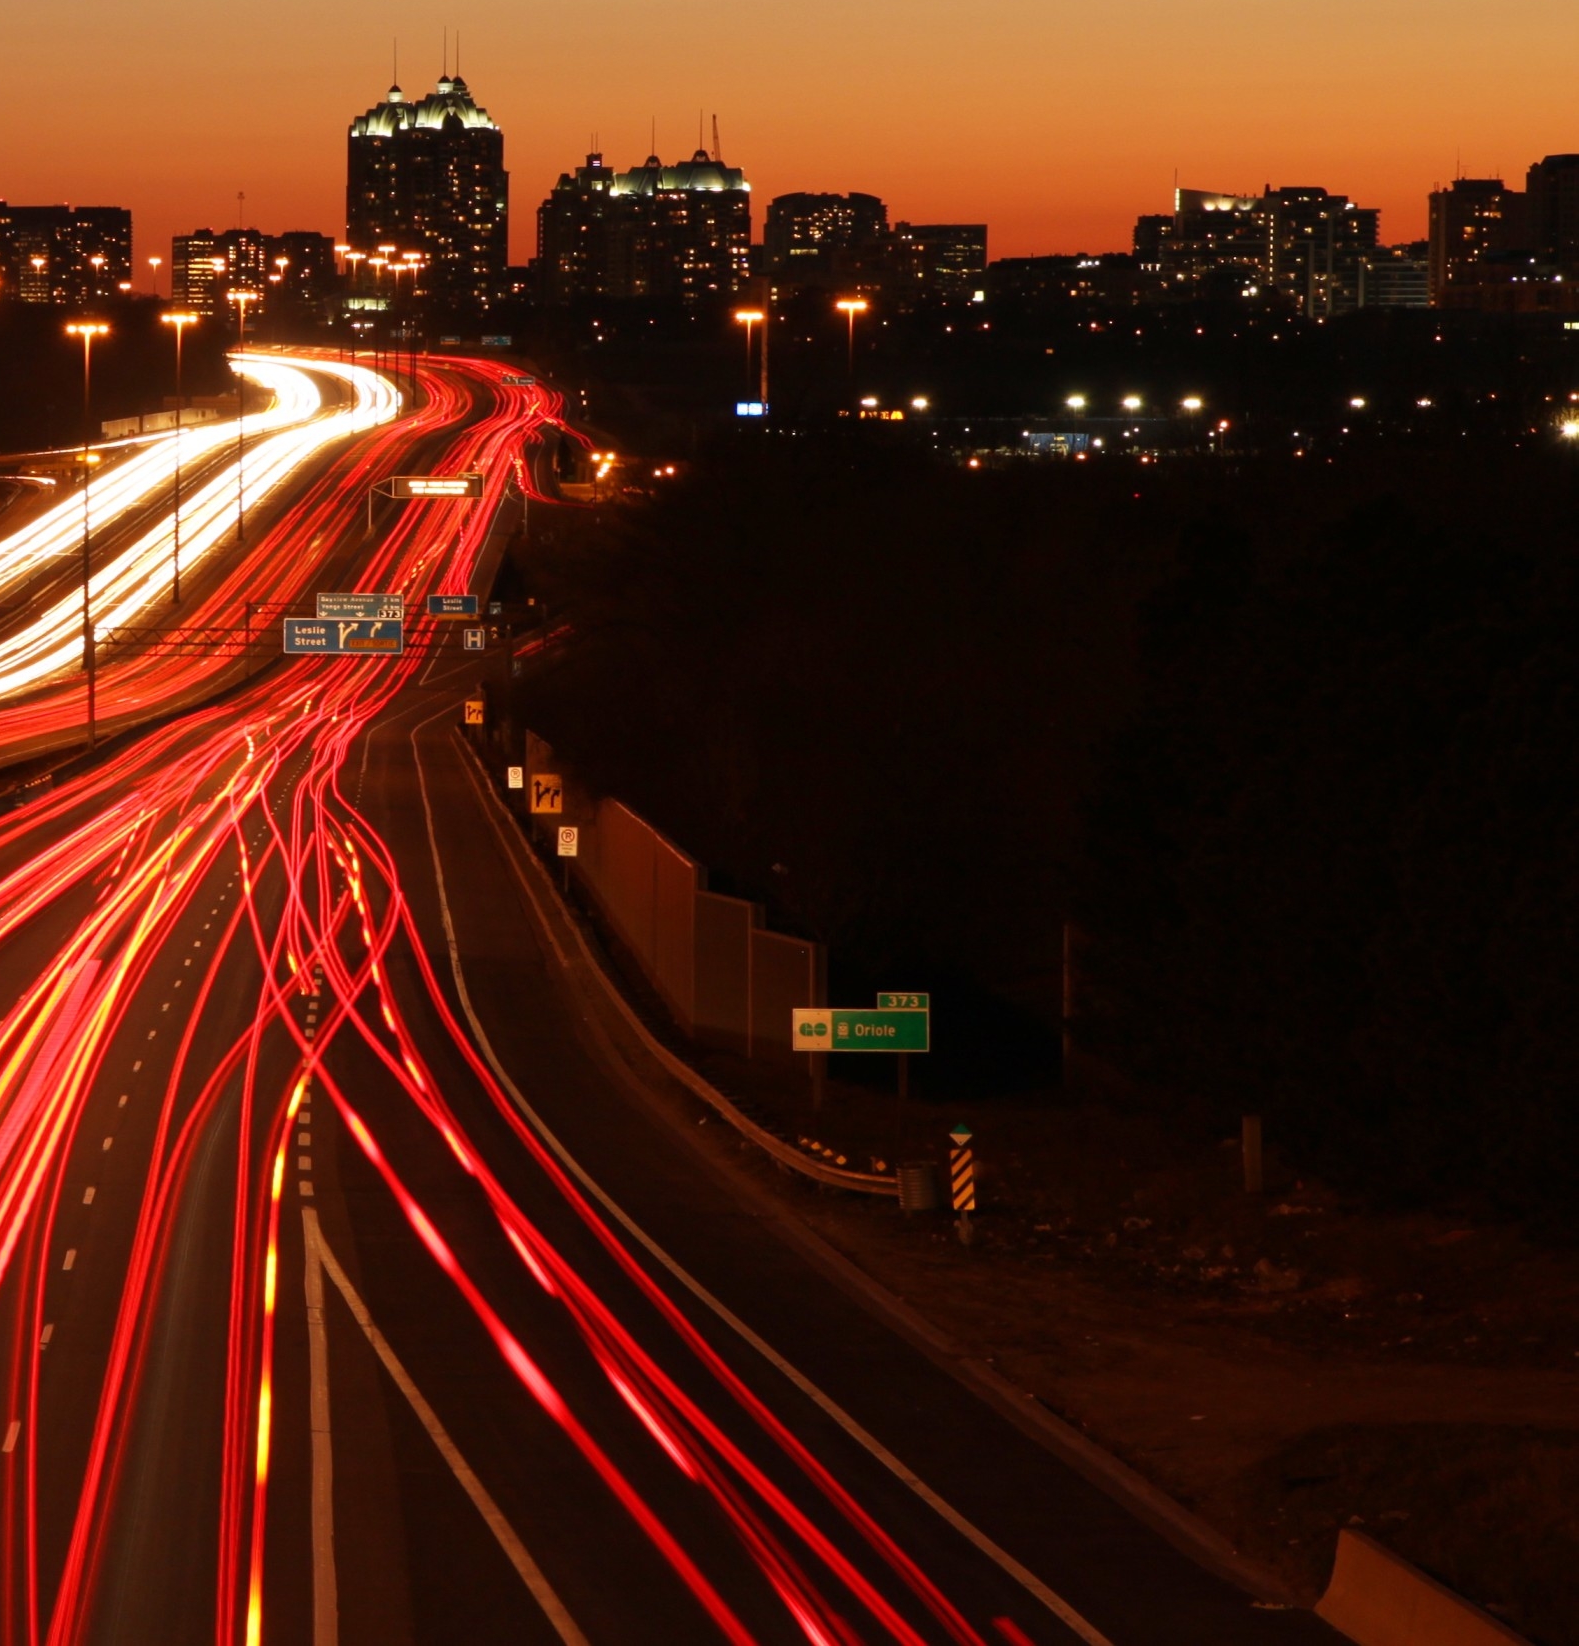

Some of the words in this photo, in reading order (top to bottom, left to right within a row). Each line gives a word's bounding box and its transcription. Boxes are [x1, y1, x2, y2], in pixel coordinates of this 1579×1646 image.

[295, 626, 326, 634] Leslie
[295, 638, 326, 646] Street
[889, 996, 919, 1007] 373
[855, 1024, 896, 1037] Oriole
